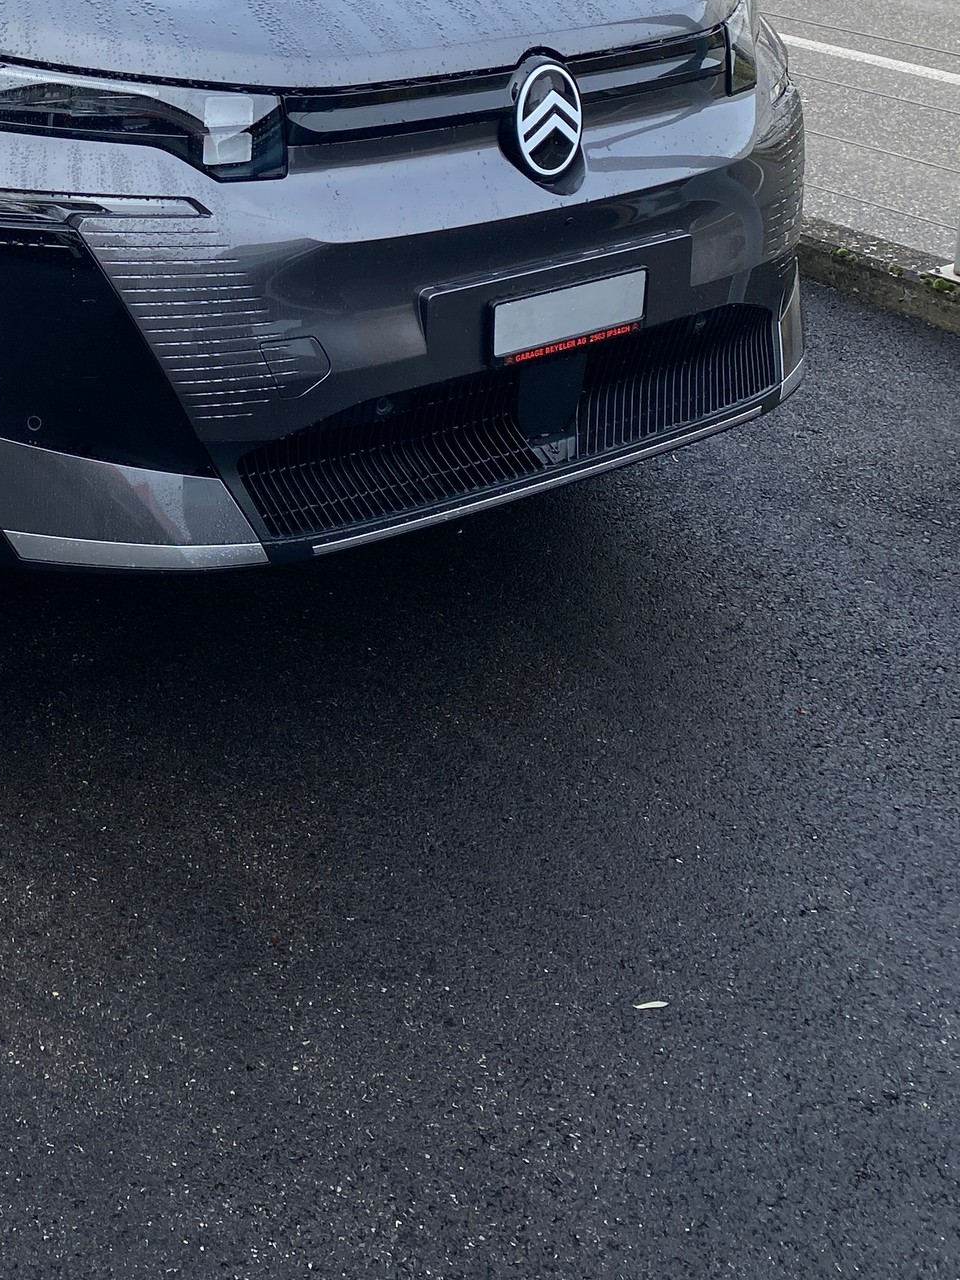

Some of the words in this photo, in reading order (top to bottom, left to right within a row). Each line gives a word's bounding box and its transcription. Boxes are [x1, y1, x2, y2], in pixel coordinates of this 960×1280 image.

[515, 348, 544, 362] GARAGE
[545, 340, 576, 354] BEYELER
[577, 337, 587, 346] AG
[589, 332, 606, 342] 2563
[606, 325, 630, 338] IPSACH
